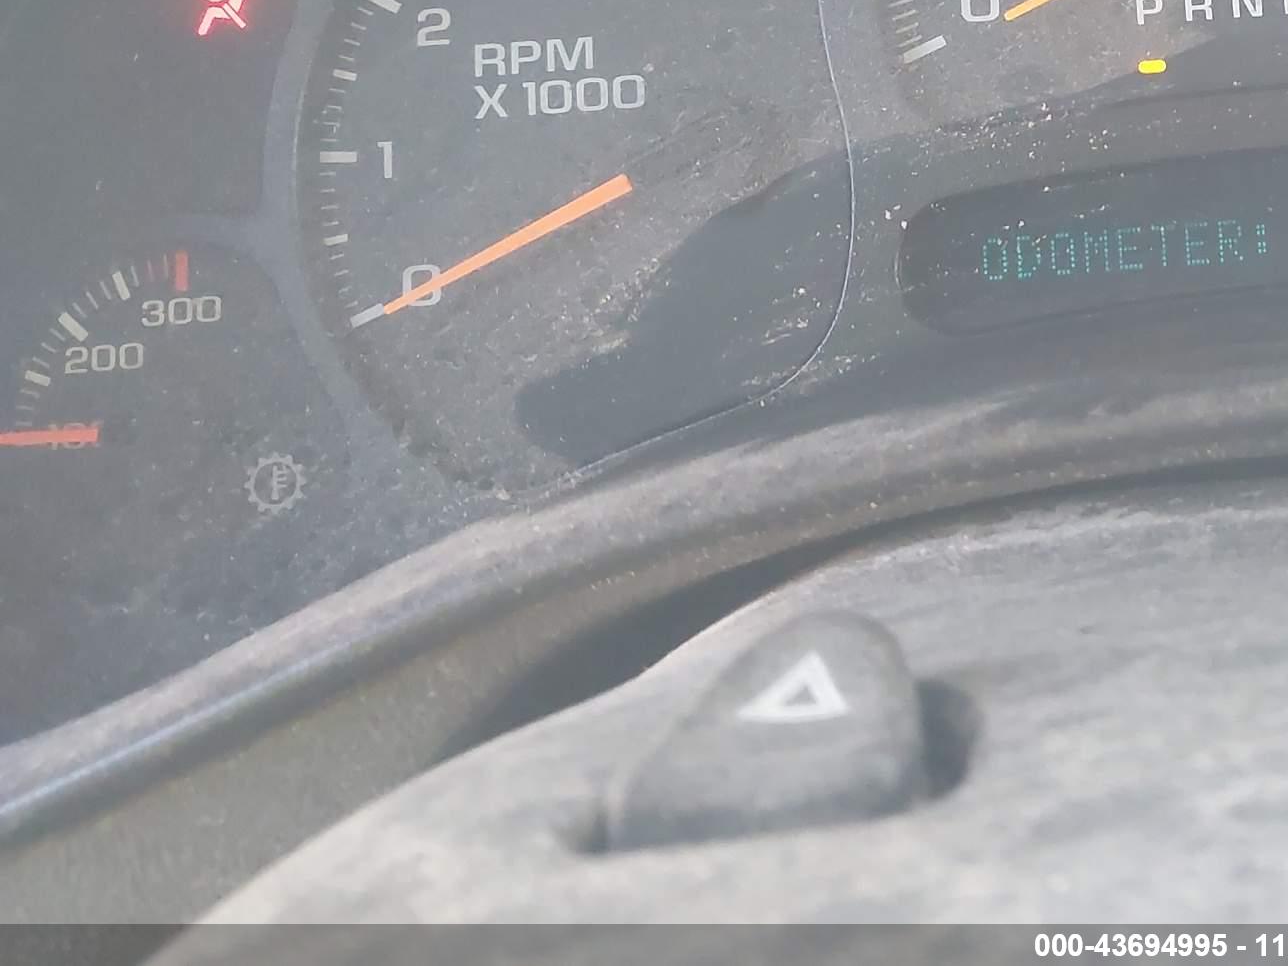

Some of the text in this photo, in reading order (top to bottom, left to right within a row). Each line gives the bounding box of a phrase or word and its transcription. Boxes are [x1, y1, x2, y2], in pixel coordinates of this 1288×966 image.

[416, 8, 451, 46] 2
[473, 36, 595, 77] RPM
[473, 74, 646, 120] X 1000
[377, 140, 393, 179] 1
[983, 220, 1267, 281] ODOMETER:
[402, 264, 442, 306] 0
[141, 295, 222, 327] 300
[64, 342, 144, 375] 200
